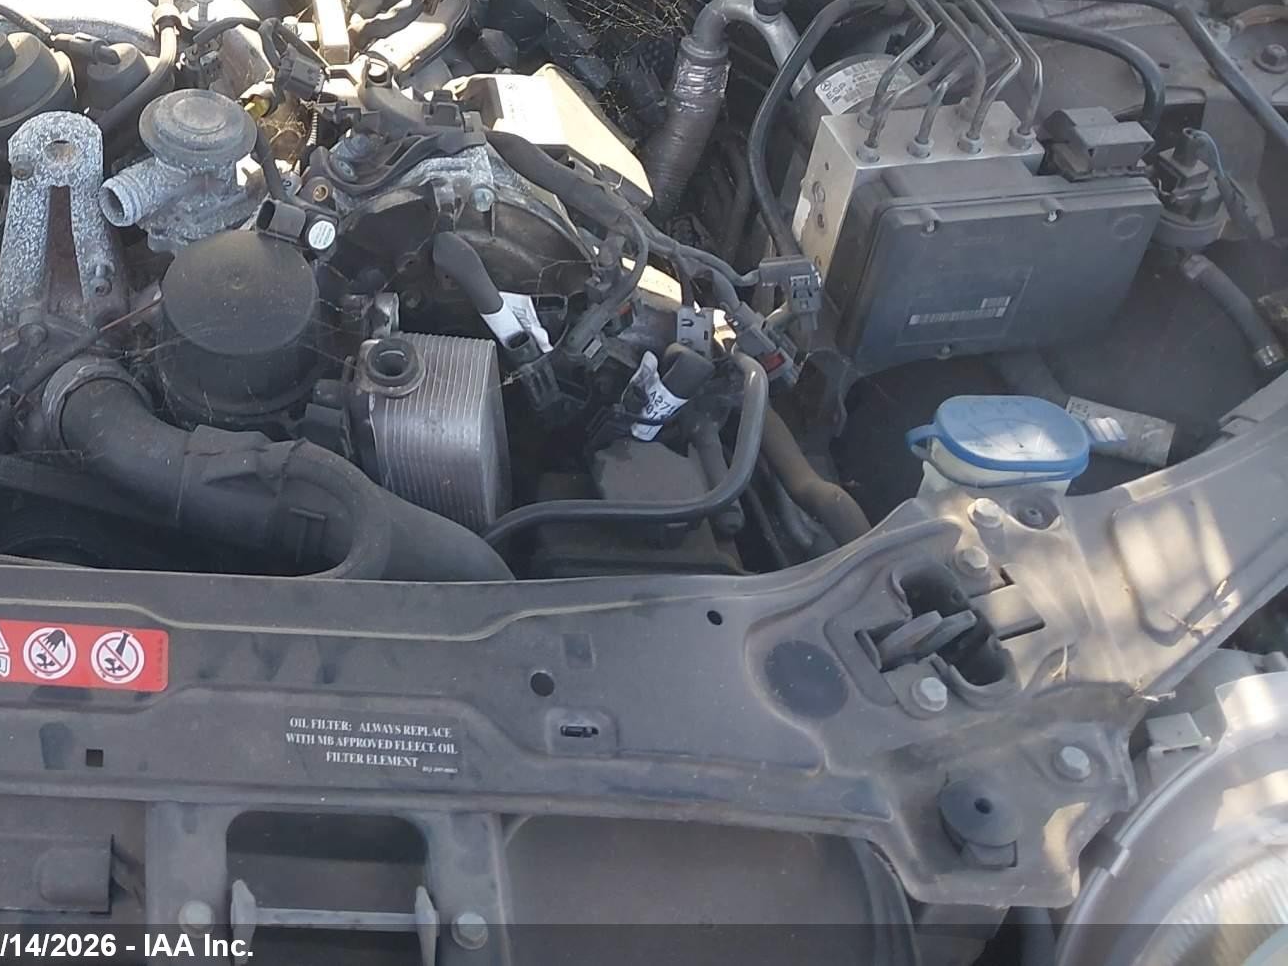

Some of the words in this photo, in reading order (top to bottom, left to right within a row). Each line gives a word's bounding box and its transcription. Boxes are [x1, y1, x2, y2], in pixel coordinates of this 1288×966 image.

[289, 717, 309, 729] OIL
[311, 718, 352, 732] FILTER:
[359, 722, 402, 735] ALWAYS
[403, 725, 452, 739] REPLACE
[286, 733, 315, 745] WITH
[317, 735, 335, 746] MB
[336, 737, 393, 750] APPROVED
[394, 740, 438, 753] FLEECE
[438, 743, 459, 755] OIL
[325, 751, 364, 764] FILTER
[366, 754, 419, 768] ELEMENT
